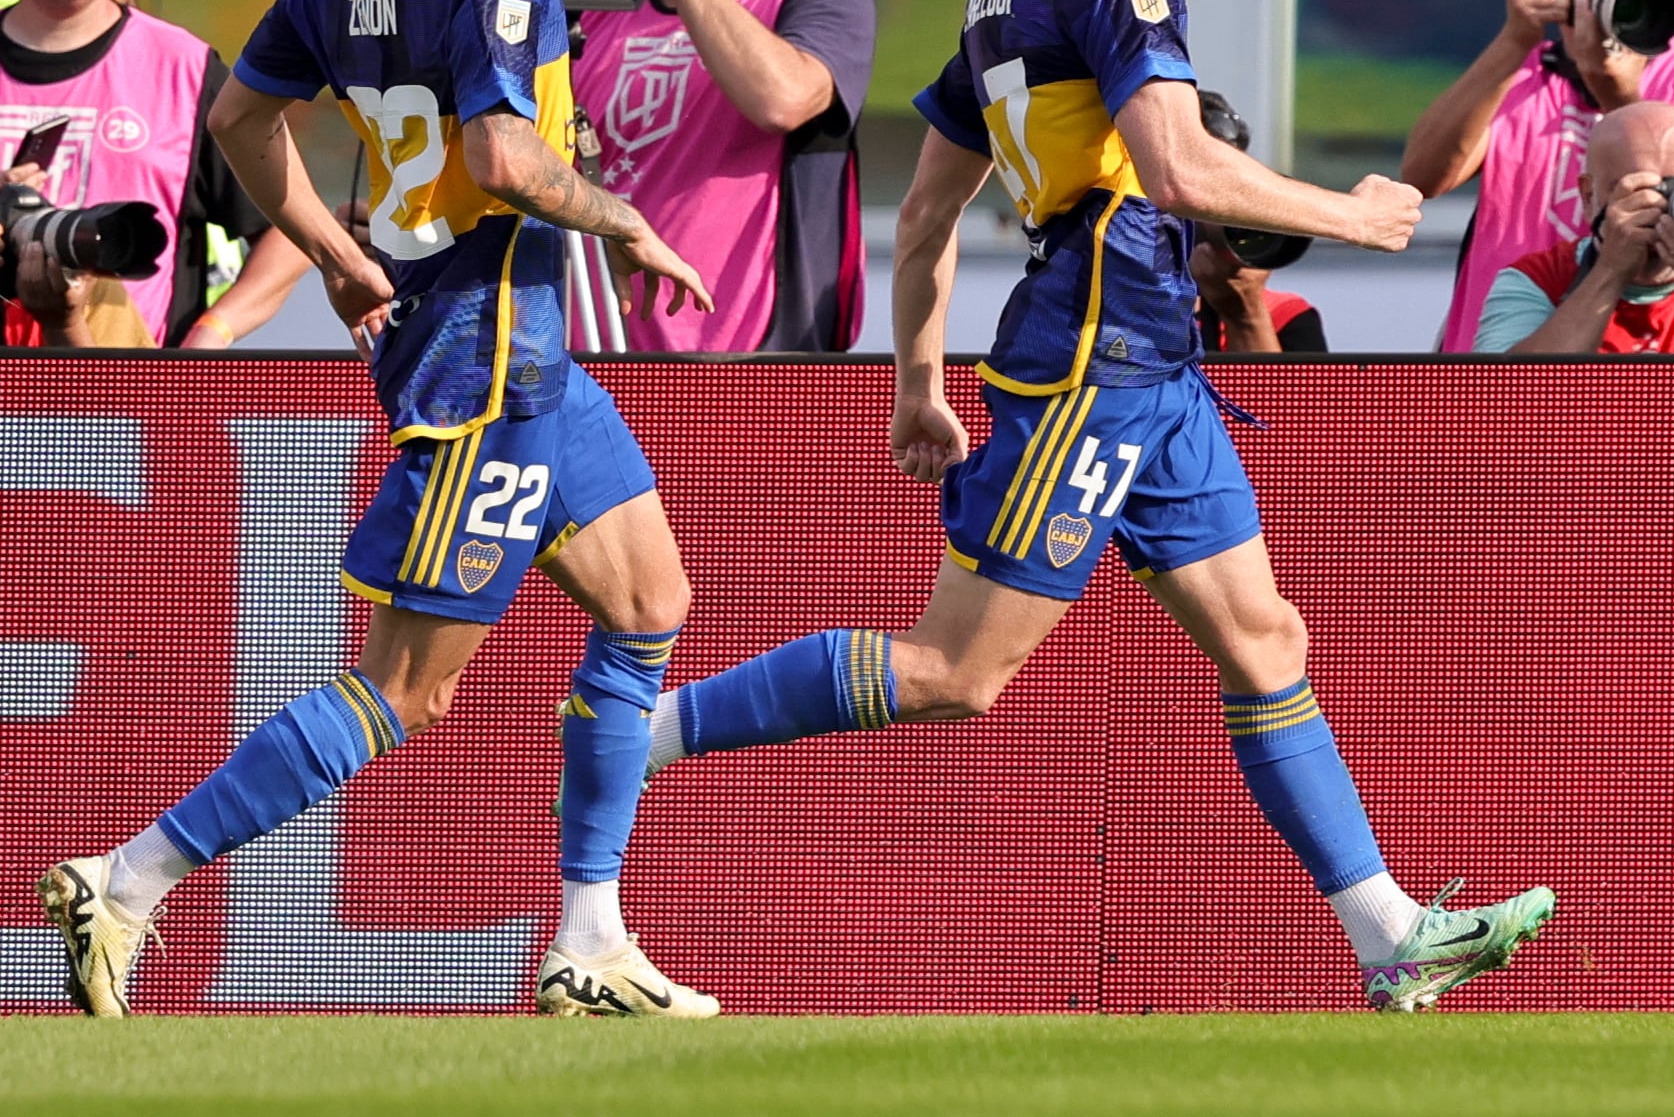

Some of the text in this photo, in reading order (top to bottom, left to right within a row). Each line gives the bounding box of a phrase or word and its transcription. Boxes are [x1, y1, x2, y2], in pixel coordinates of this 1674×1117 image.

[107, 118, 141, 141] 29
[1067, 435, 1142, 518] 47
[464, 460, 549, 541] 22
[1050, 529, 1083, 545] CABJ
[461, 556, 495, 571] CABJ
